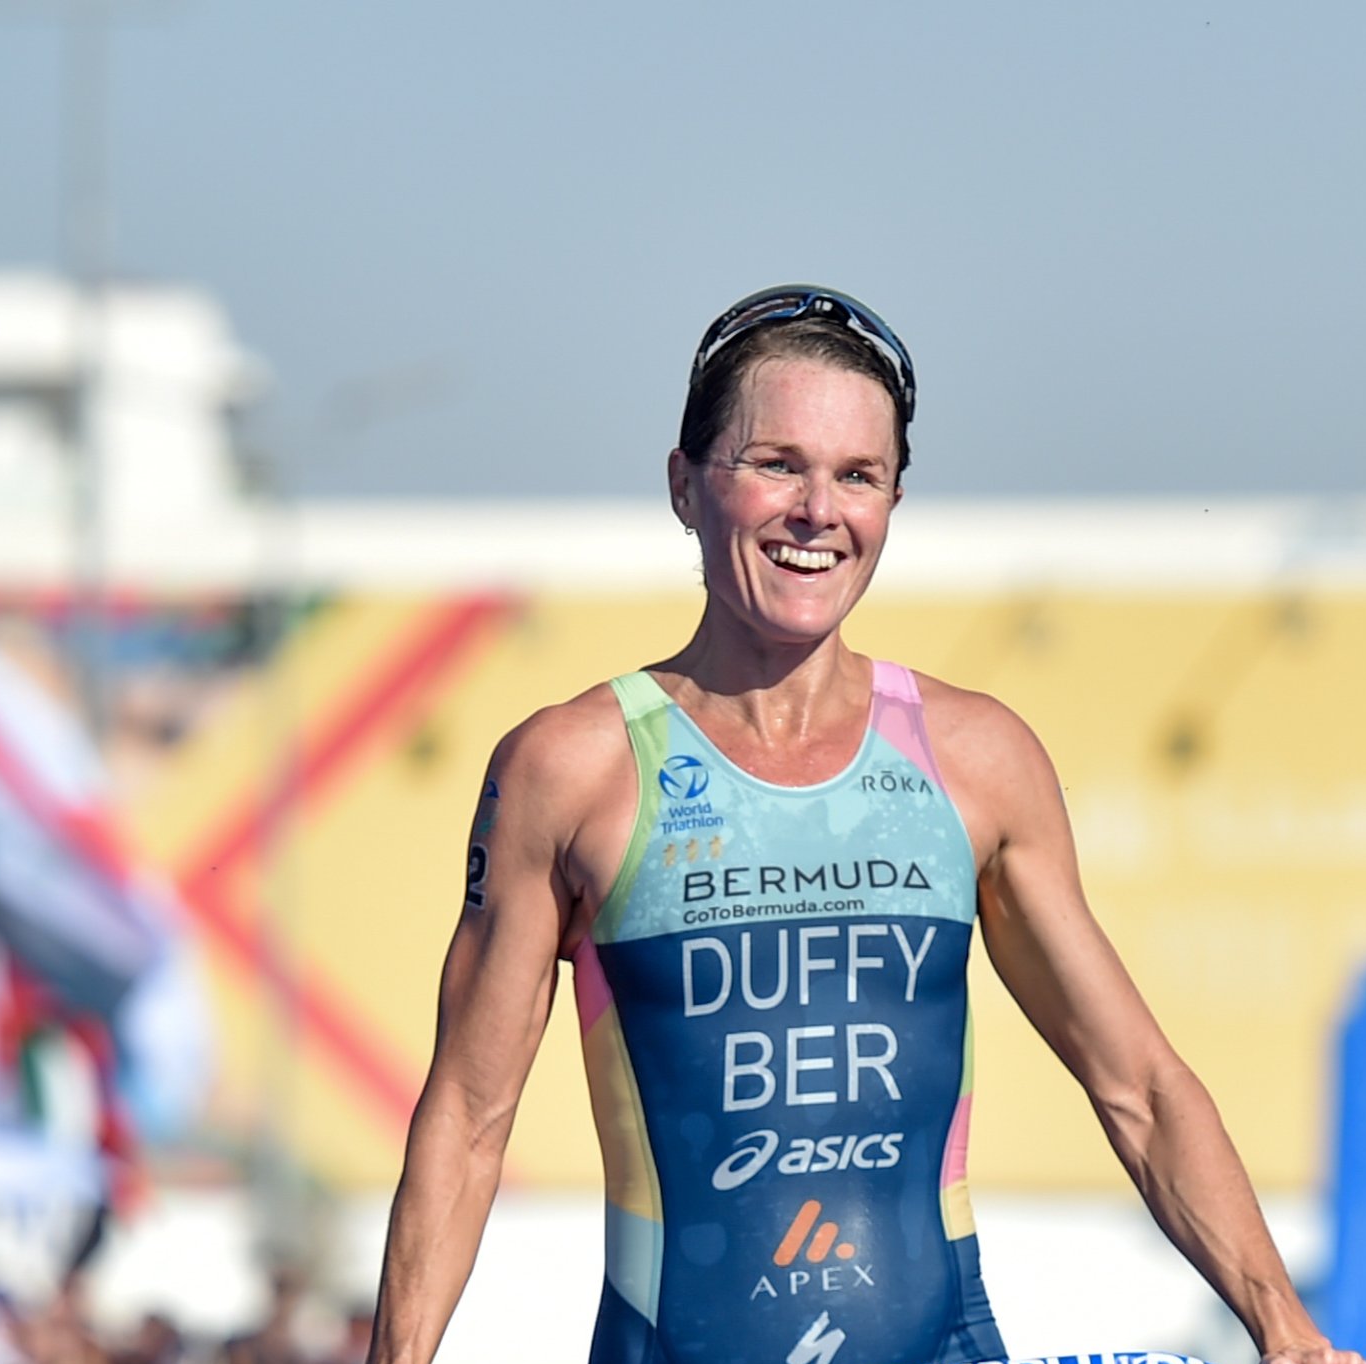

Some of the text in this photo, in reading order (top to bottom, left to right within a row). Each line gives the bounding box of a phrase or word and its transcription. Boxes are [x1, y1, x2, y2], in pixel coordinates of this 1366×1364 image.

[661, 816, 724, 835] Triathlon
[668, 802, 712, 819] World
[682, 859, 933, 903] BERMUDA
[682, 898, 866, 925] GoToBermuda.com
[682, 923, 938, 1018] DUFFY
[722, 1023, 903, 1113] BER
[749, 1263, 875, 1301] APEX
